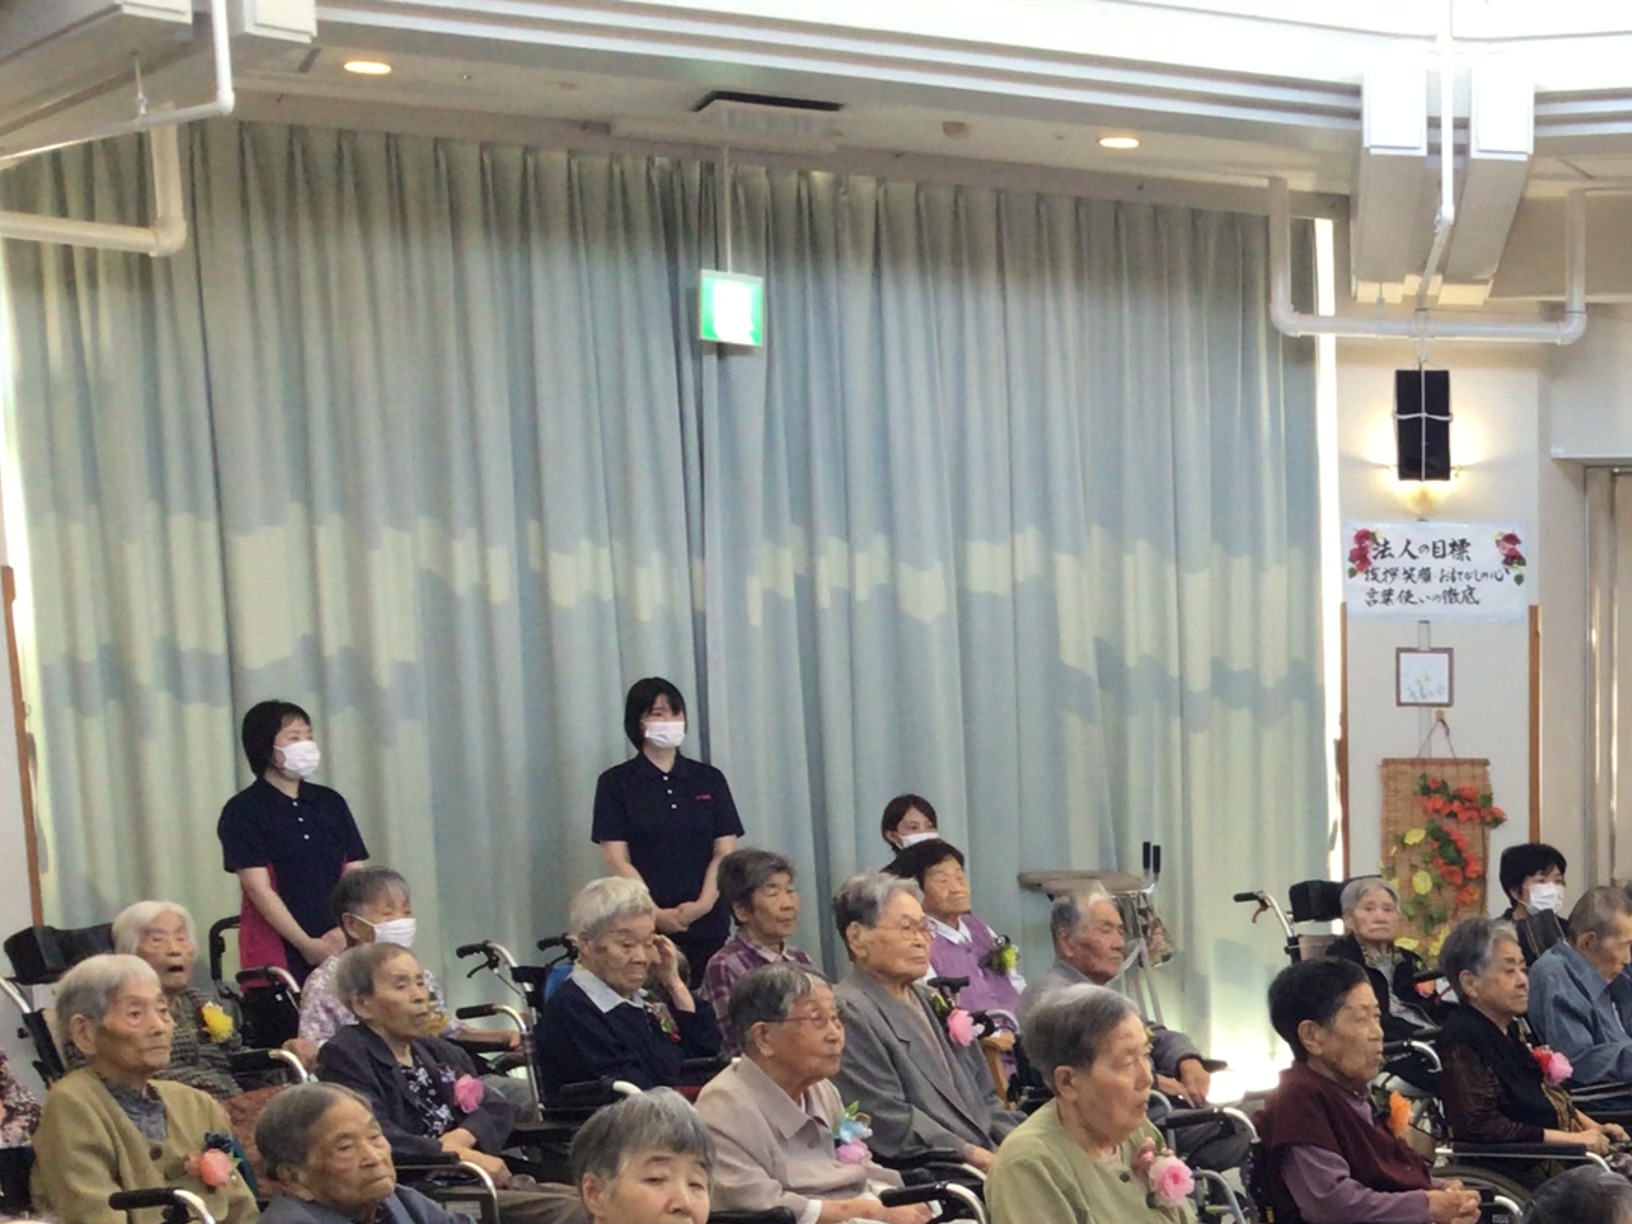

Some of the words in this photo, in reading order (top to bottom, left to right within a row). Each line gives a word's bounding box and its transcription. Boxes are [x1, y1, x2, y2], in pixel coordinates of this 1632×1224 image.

[1371, 537, 1472, 562] 法人の目標
[1365, 584, 1481, 607] 言葉使いの徹底
